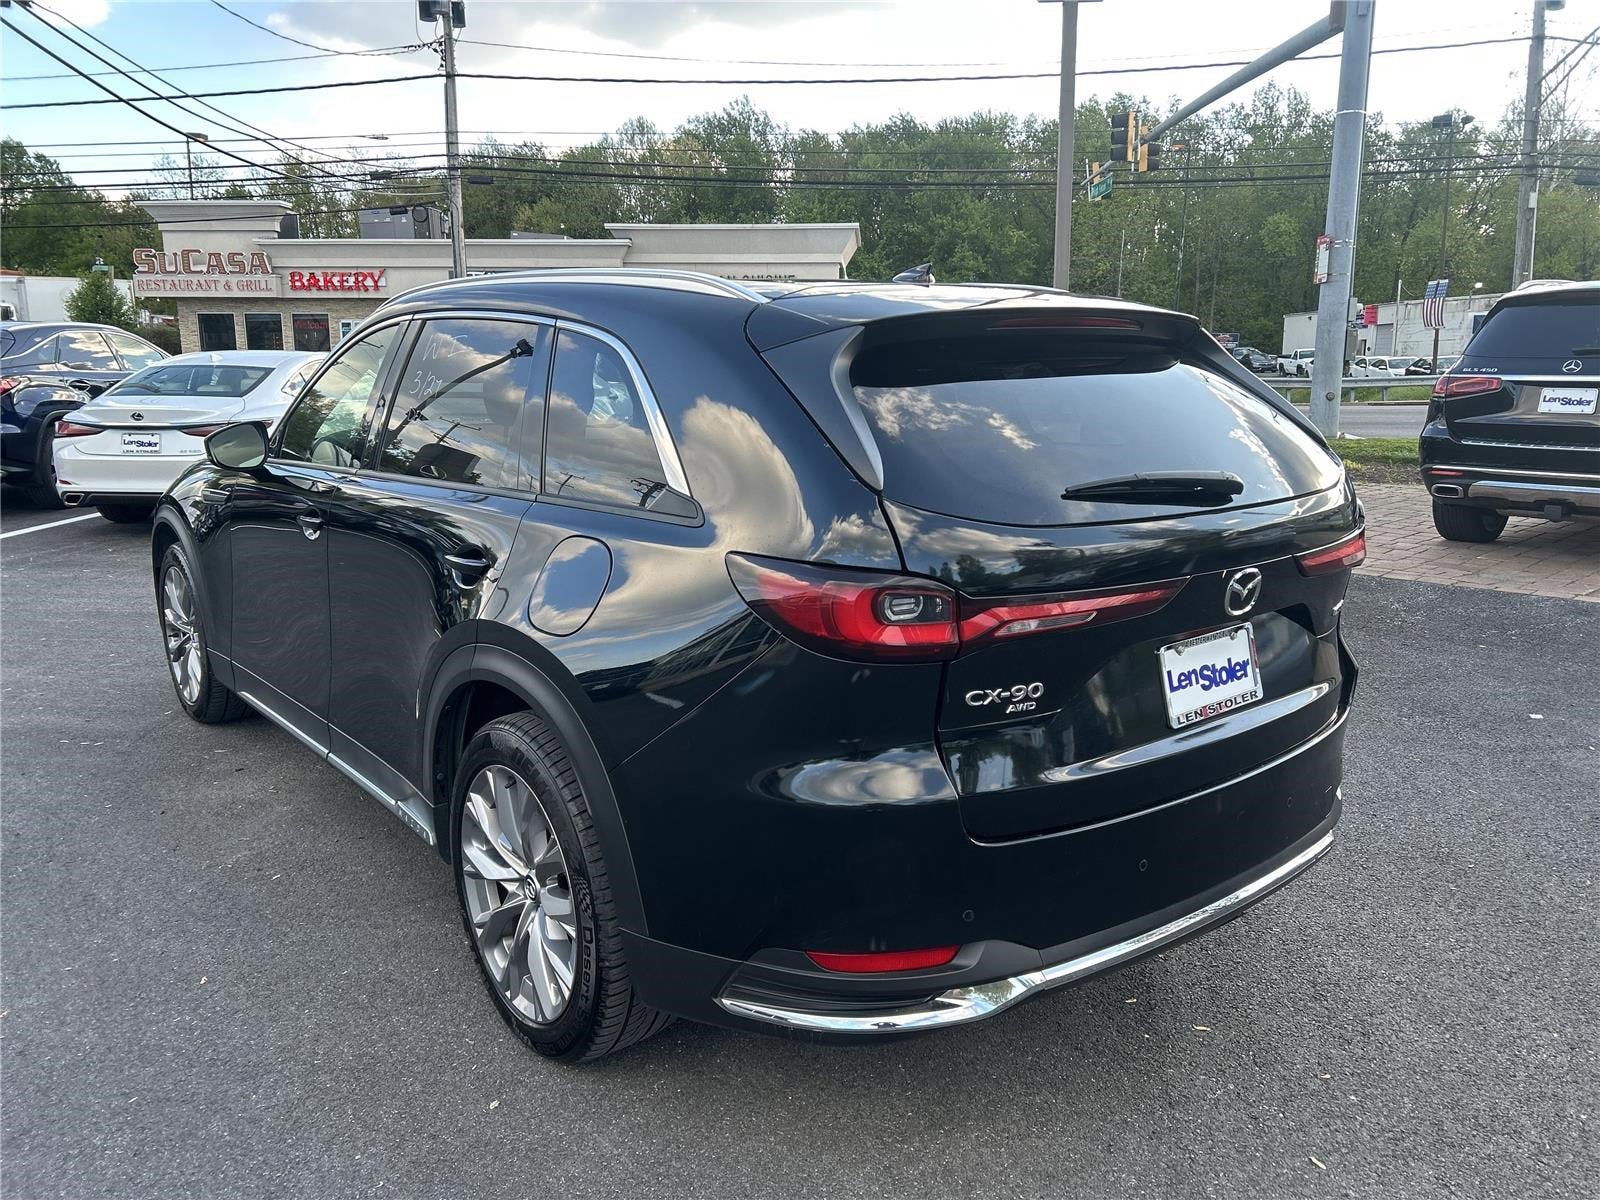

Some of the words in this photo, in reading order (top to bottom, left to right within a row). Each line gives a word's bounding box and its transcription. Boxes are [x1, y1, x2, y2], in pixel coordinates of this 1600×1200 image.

[137, 279, 219, 292] RESTAURANT
[223, 279, 232, 291] &
[236, 279, 273, 292] GRILL
[289, 268, 386, 293] BAKERY
[964, 682, 1045, 707] CX-90
[1004, 701, 1037, 714] AWD
[1176, 708, 1204, 726] LEN
[1207, 689, 1259, 715] STOLER
[580, 926, 594, 1003] Desert
